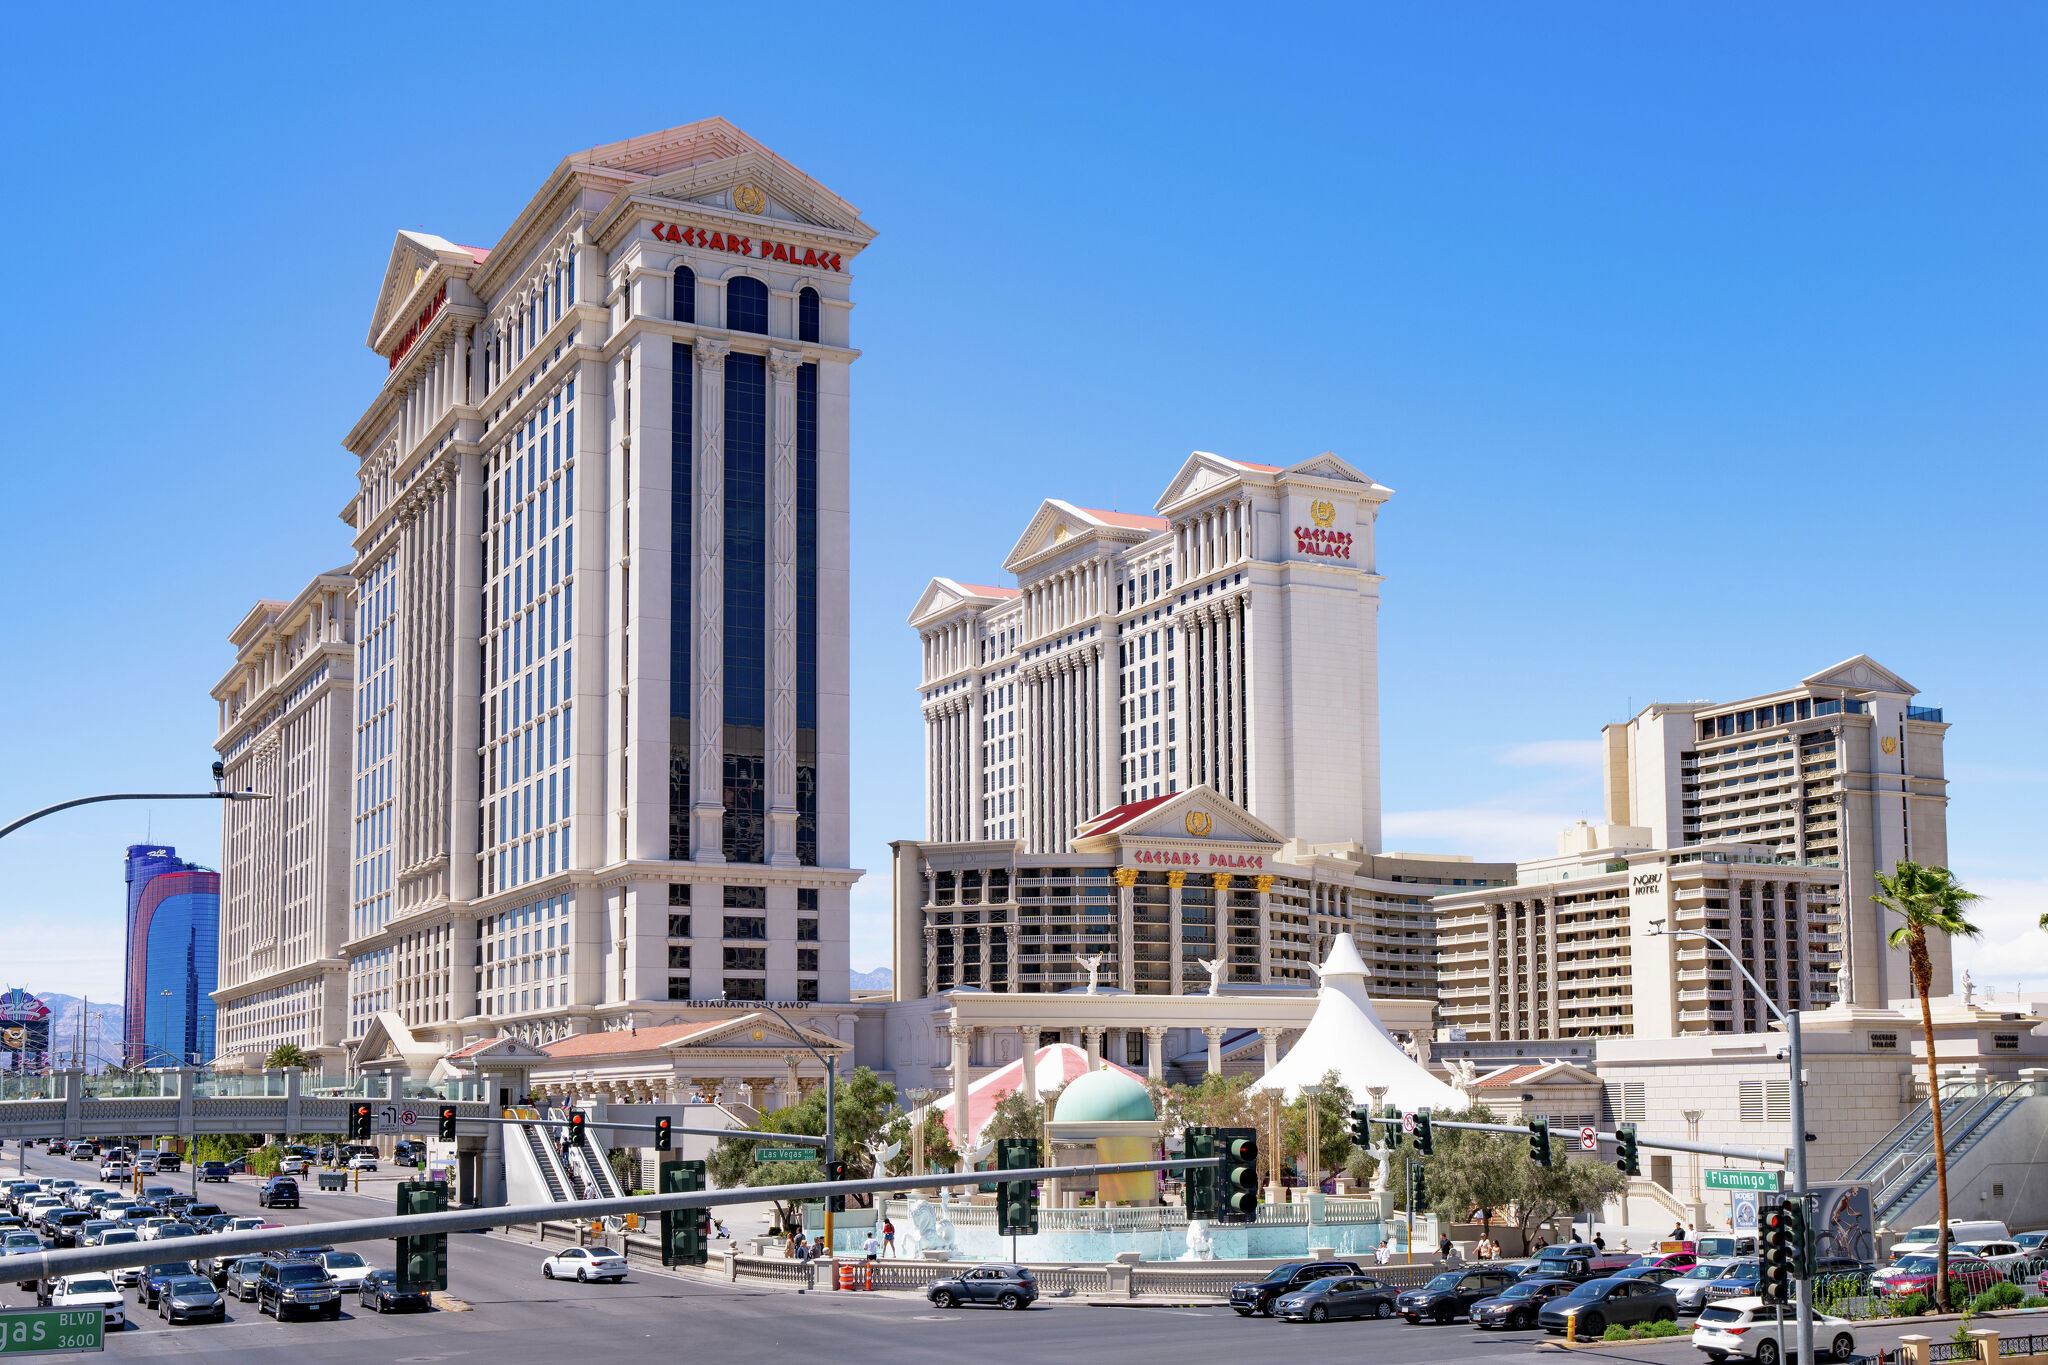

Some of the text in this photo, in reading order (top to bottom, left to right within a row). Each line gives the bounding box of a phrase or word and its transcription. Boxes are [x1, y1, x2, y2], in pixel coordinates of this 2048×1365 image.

[651, 221, 841, 272] CAESARS PALACE
[1294, 527, 1353, 546] CAESARS
[1297, 540, 1350, 560] PALACE
[1134, 850, 1263, 870] CAESARS PALACE
[1633, 874, 1662, 886] NOBU
[1635, 885, 1659, 896] HOTEL
[777, 1001, 810, 1009] SAVOY
[763, 1150, 777, 1158] Las
[779, 1150, 802, 1160] Vegas
[1711, 1172, 1764, 1188] Flamingo
[1769, 1173, 1776, 1181] RD
[59, 1312, 95, 1326] BLVD
[58, 1333, 95, 1348] 3600
